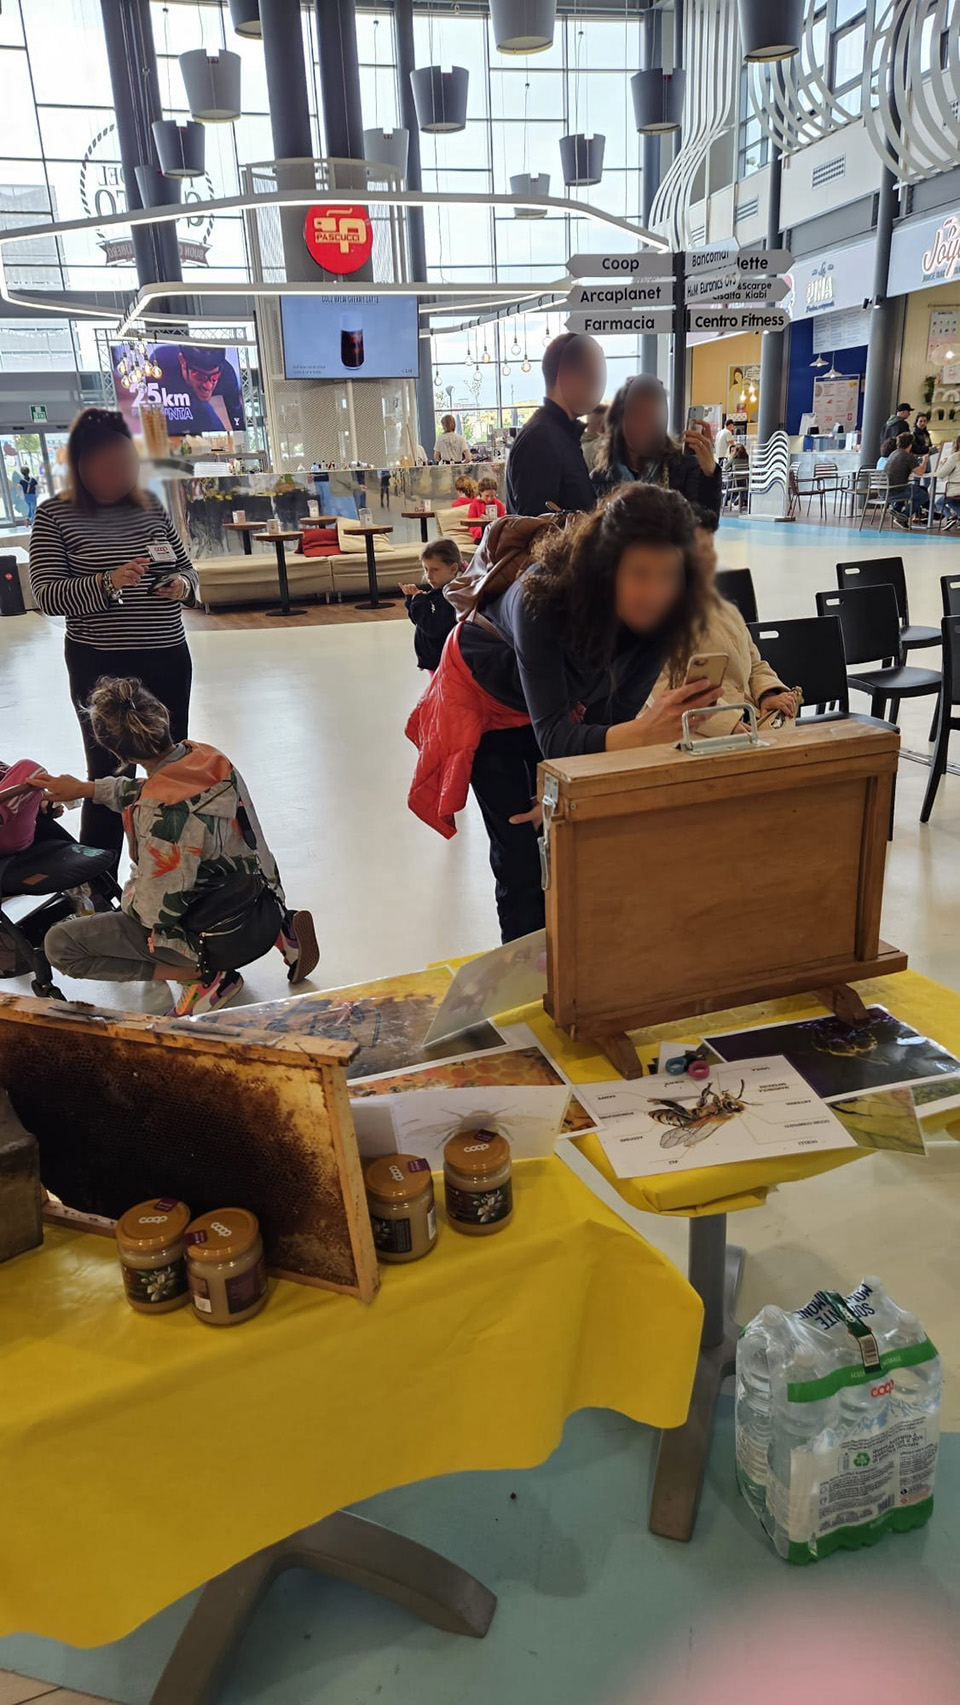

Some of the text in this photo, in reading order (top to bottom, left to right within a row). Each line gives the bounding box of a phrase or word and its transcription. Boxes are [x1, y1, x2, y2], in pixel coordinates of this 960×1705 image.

[315, 233, 360, 242] PASCUCCI
[601, 257, 640, 273] Coop
[580, 286, 662, 303] Arcaplanet
[700, 278, 723, 295] Euronics
[745, 289, 767, 299] Kiabi
[584, 314, 655, 331] Farmacia
[695, 312, 785, 328] Centro Fitness
[463, 1143, 490, 1153] coop
[388, 1164, 404, 1182] coop
[138, 1215, 168, 1224] coop
[210, 1221, 232, 1238] coop
